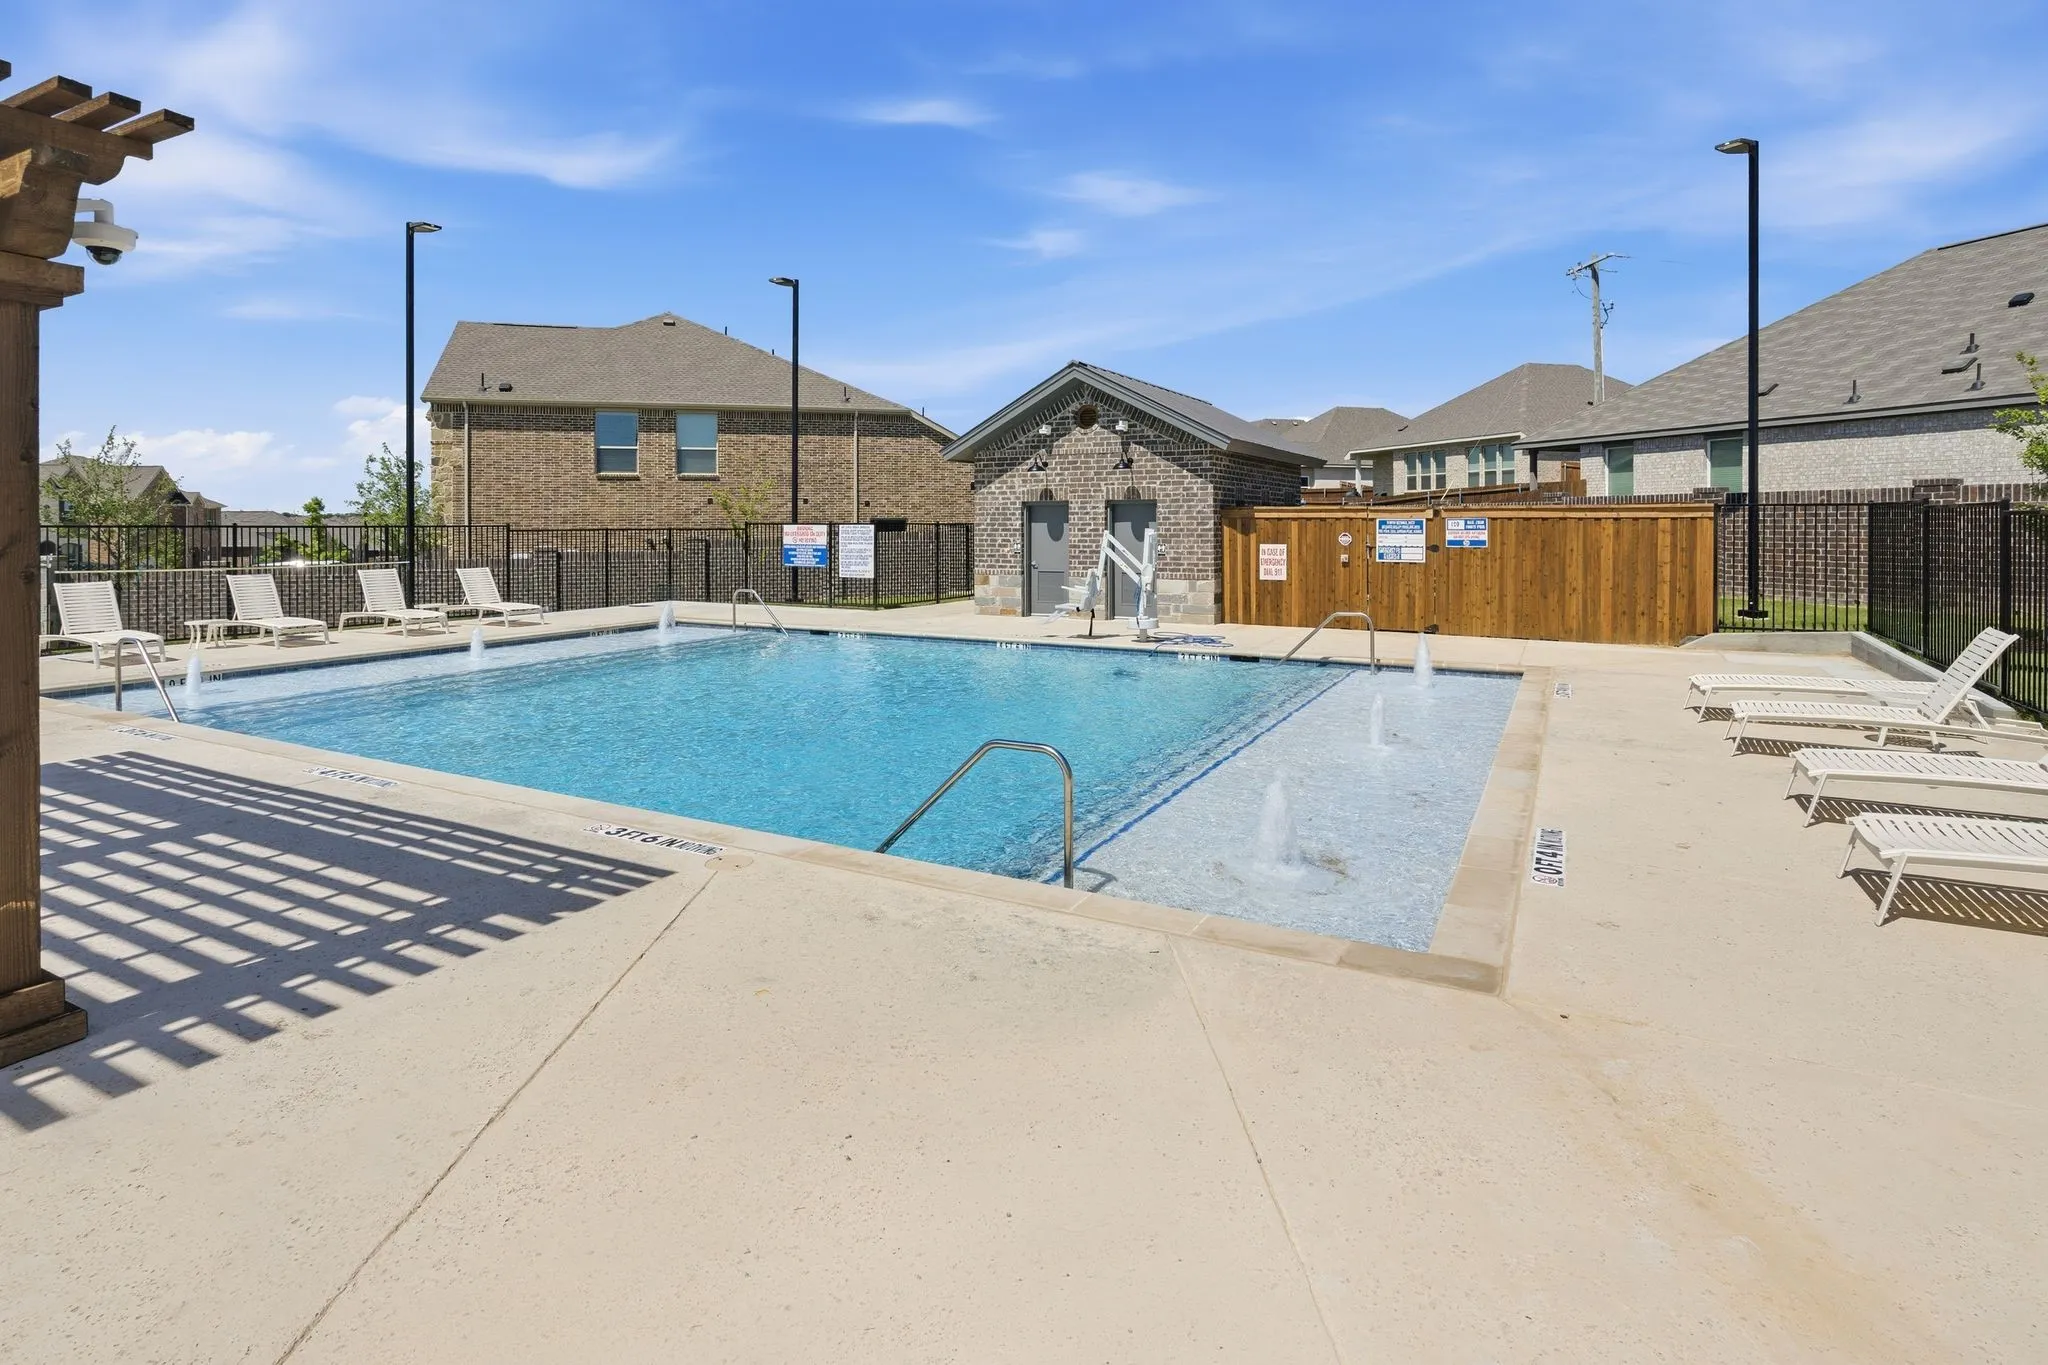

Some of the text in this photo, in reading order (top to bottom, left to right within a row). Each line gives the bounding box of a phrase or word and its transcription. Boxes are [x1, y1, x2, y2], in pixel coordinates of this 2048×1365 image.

[1261, 548, 1285, 556] IN CASE OF
[1260, 557, 1286, 566] EMERGENCY
[1263, 568, 1283, 576] DIAL 911
[604, 827, 628, 836] 3
[617, 829, 650, 841] FT
[639, 834, 664, 843] 6
[655, 837, 685, 849] IN
[1536, 850, 1564, 859] 4
[1535, 857, 1563, 869] FT
